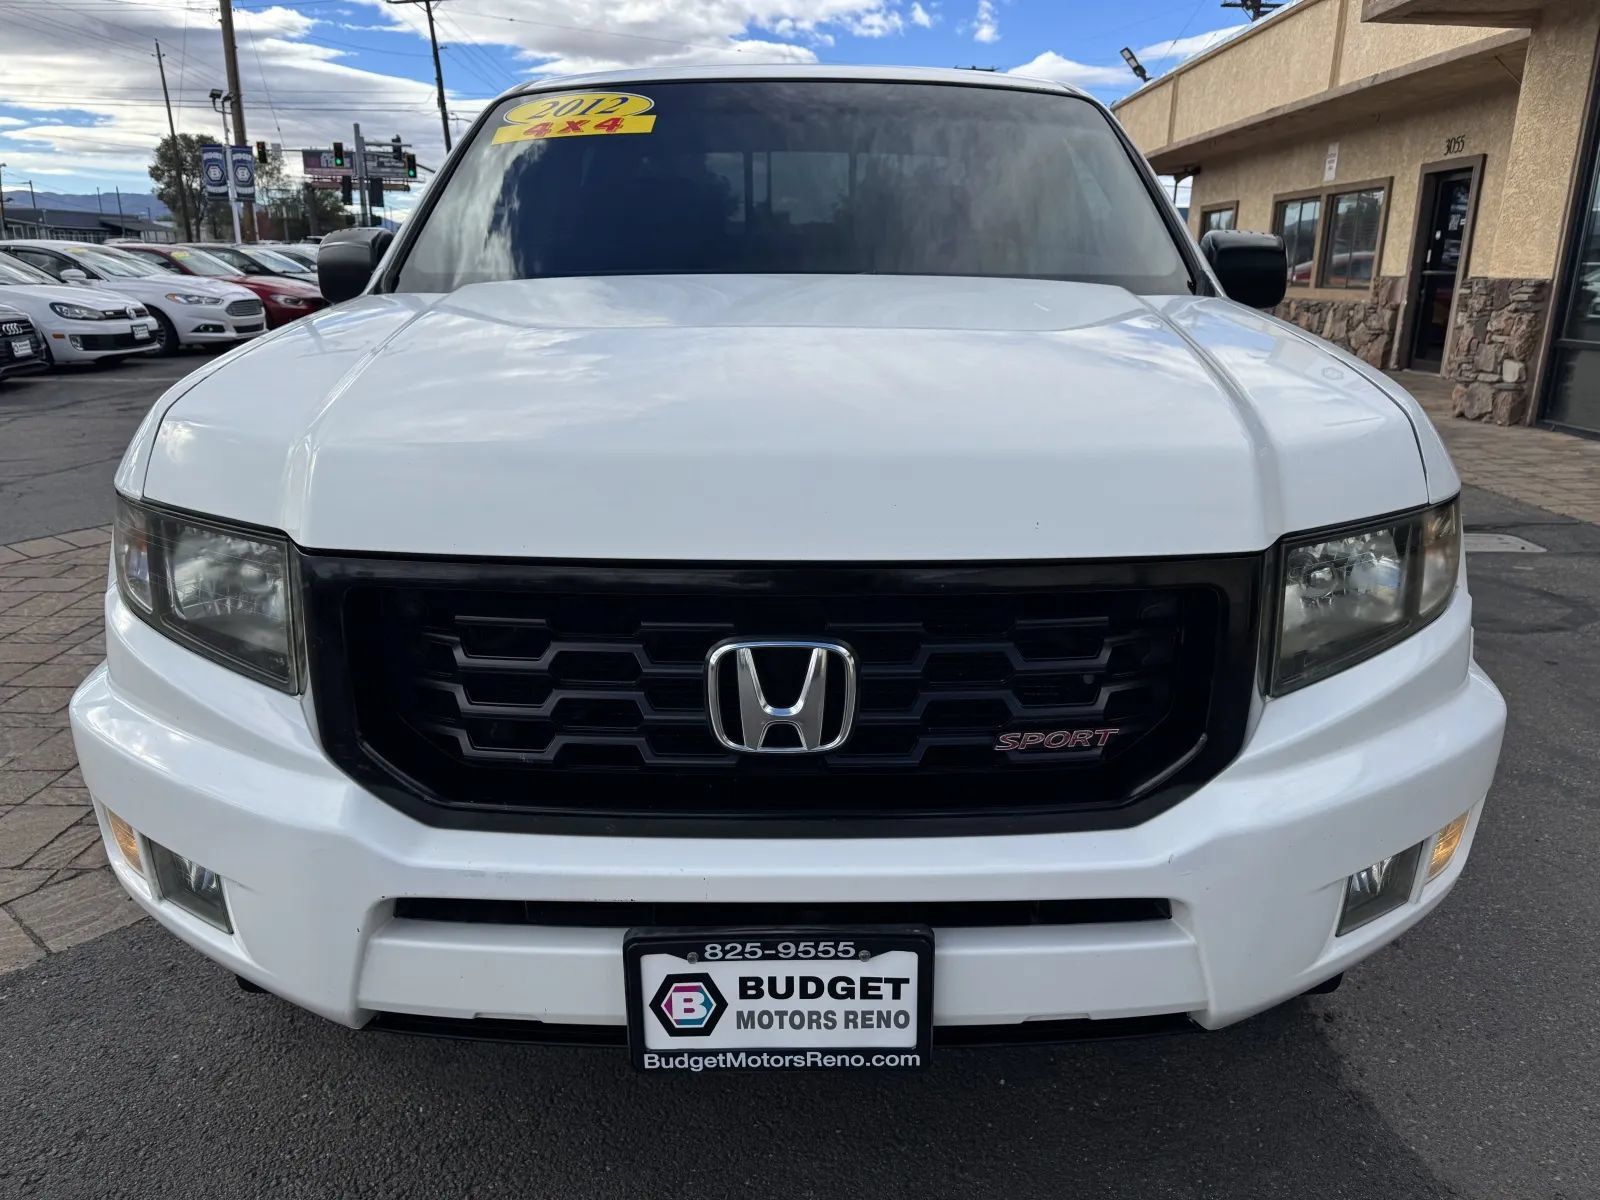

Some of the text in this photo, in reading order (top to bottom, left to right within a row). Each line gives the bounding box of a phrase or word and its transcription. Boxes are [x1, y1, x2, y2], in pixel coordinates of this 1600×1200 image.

[526, 97, 629, 120] 2012
[1444, 134, 1466, 155] 3055
[994, 728, 1120, 751] SPORT
[704, 941, 856, 960] 825-9555
[738, 975, 910, 1000] BUDGET
[735, 1009, 911, 1030] MOTORS RENO
[643, 1051, 921, 1072] BudgetMotorsReno.com
